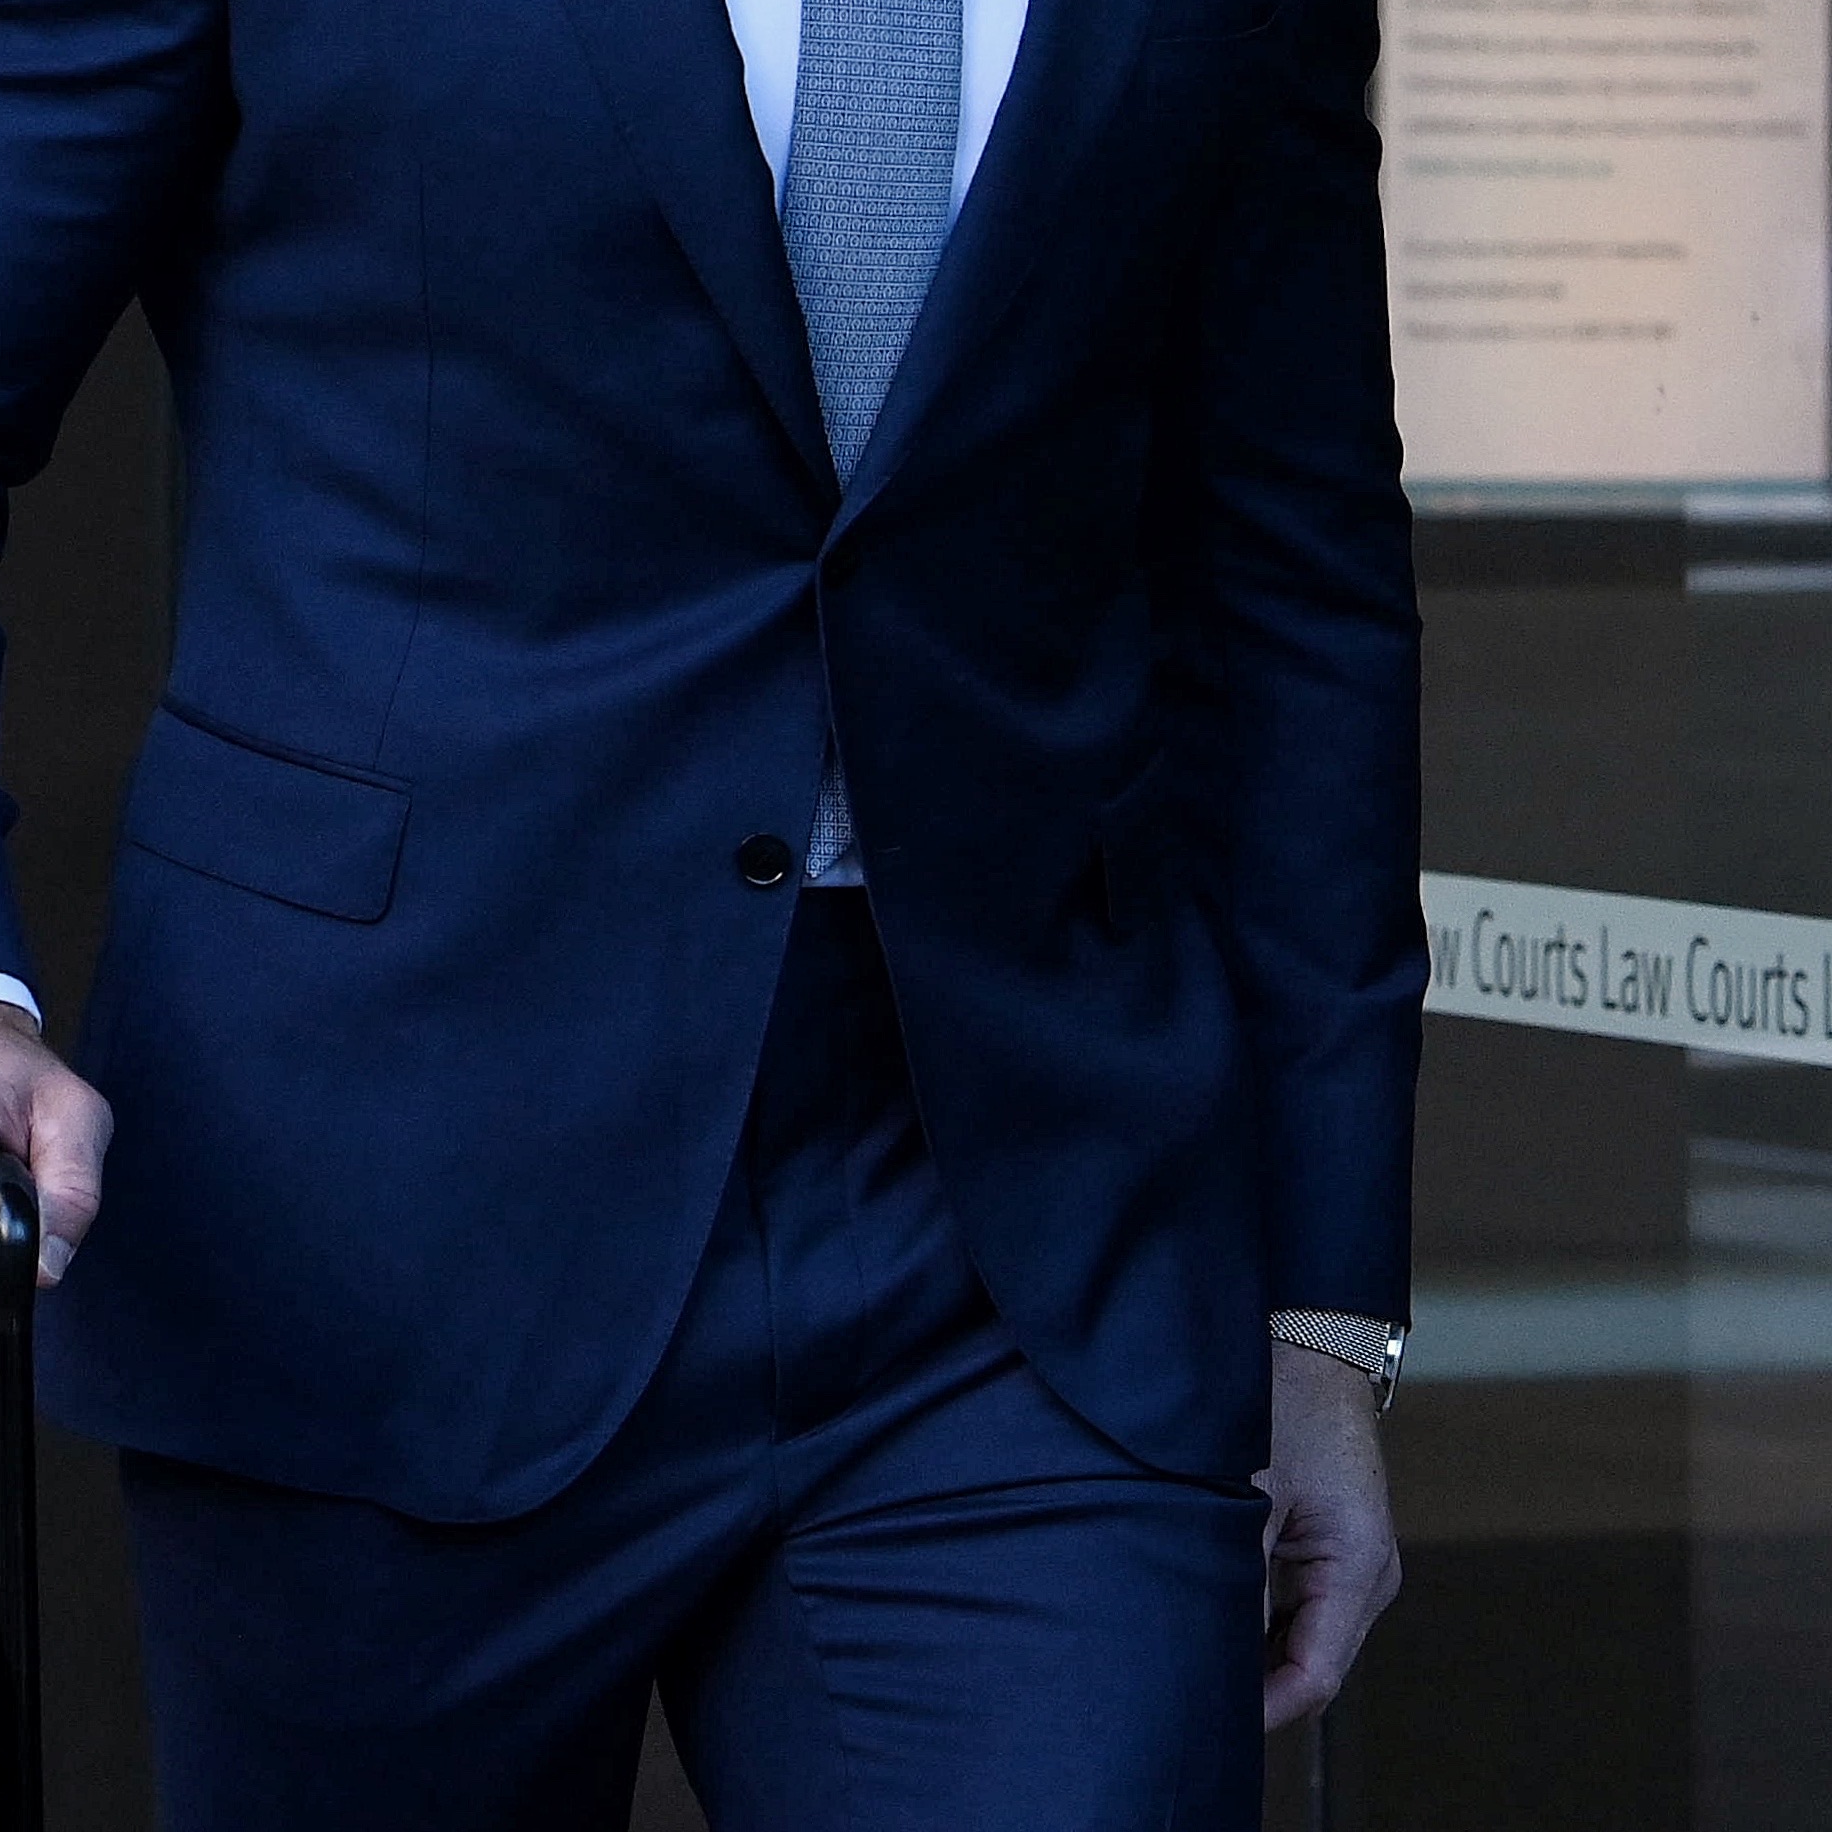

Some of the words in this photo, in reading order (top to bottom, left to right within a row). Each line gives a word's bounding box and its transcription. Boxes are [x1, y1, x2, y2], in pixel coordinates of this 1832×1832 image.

[1472, 907, 1589, 1008] Courts
[1600, 924, 1673, 1017] Law
[1686, 935, 1810, 1037] Courts
